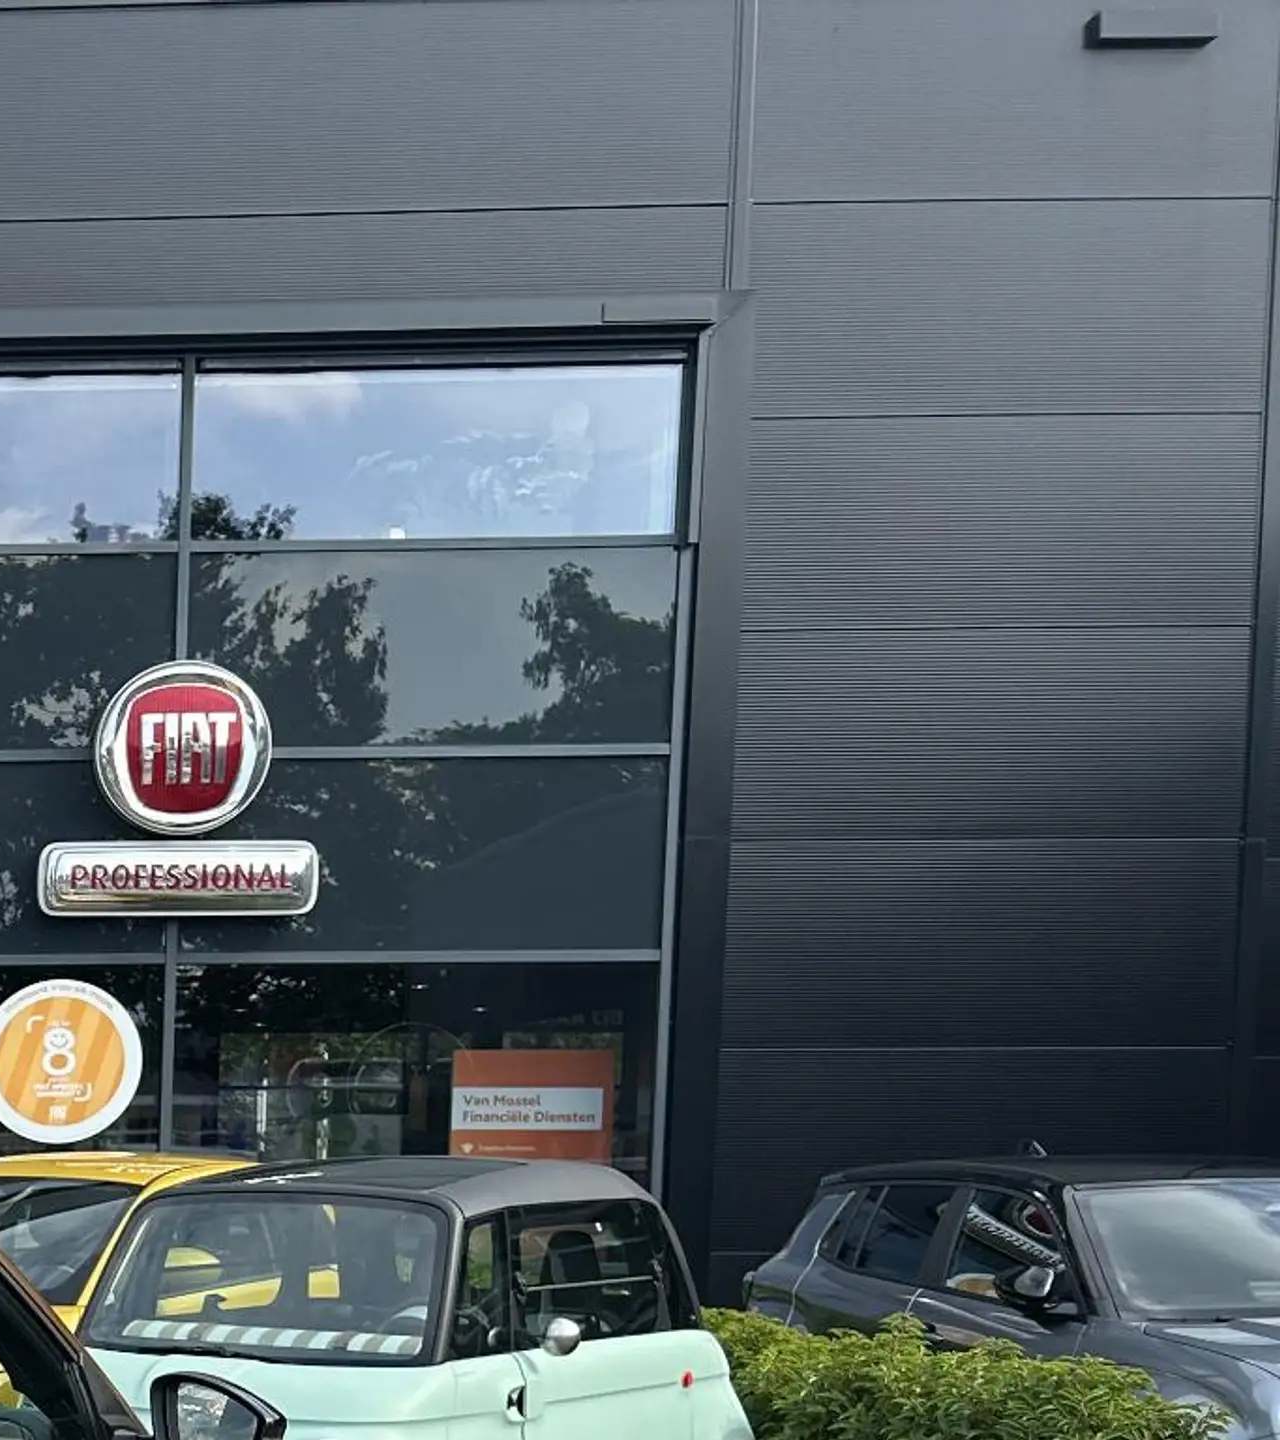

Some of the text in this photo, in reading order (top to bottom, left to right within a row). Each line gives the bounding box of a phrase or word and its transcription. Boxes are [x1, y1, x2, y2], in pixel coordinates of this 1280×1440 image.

[139, 711, 237, 786] FIAT
[69, 863, 292, 891] PROFESSIONAL
[42, 1027, 76, 1076] 8
[462, 1094, 541, 1107] Van Mossel
[462, 1109, 596, 1123] Financiële Diensten
